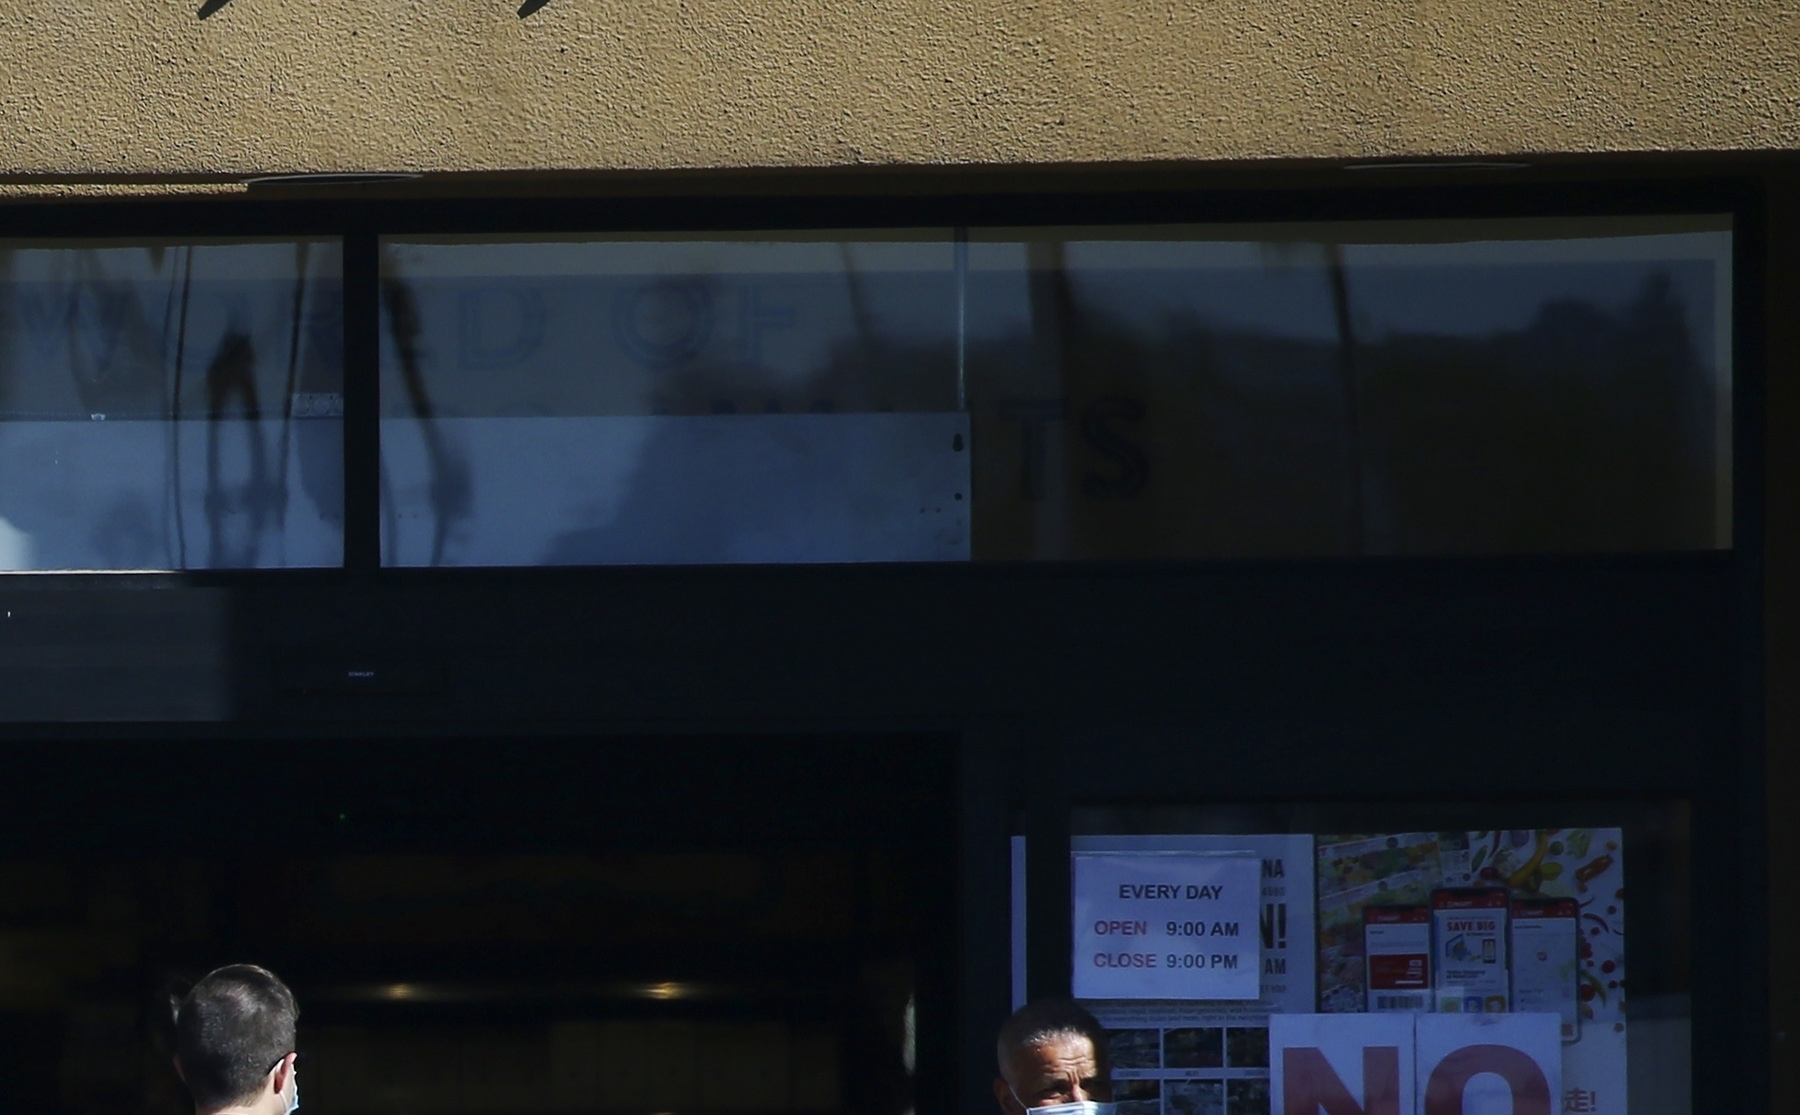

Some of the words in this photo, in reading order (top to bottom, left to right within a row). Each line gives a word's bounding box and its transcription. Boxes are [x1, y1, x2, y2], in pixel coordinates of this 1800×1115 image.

[1119, 884, 1180, 900] EVERY
[1185, 884, 1223, 899] DAY
[1094, 920, 1148, 936] OPEN
[1166, 921, 1205, 936] 9:00
[1210, 921, 1239, 936] AM
[1447, 921, 1473, 932] SAVE
[1477, 921, 1496, 932] BIG
[1094, 953, 1157, 969] CLOSE
[1166, 953, 1205, 968] 9:00
[1210, 953, 1238, 968] PM
